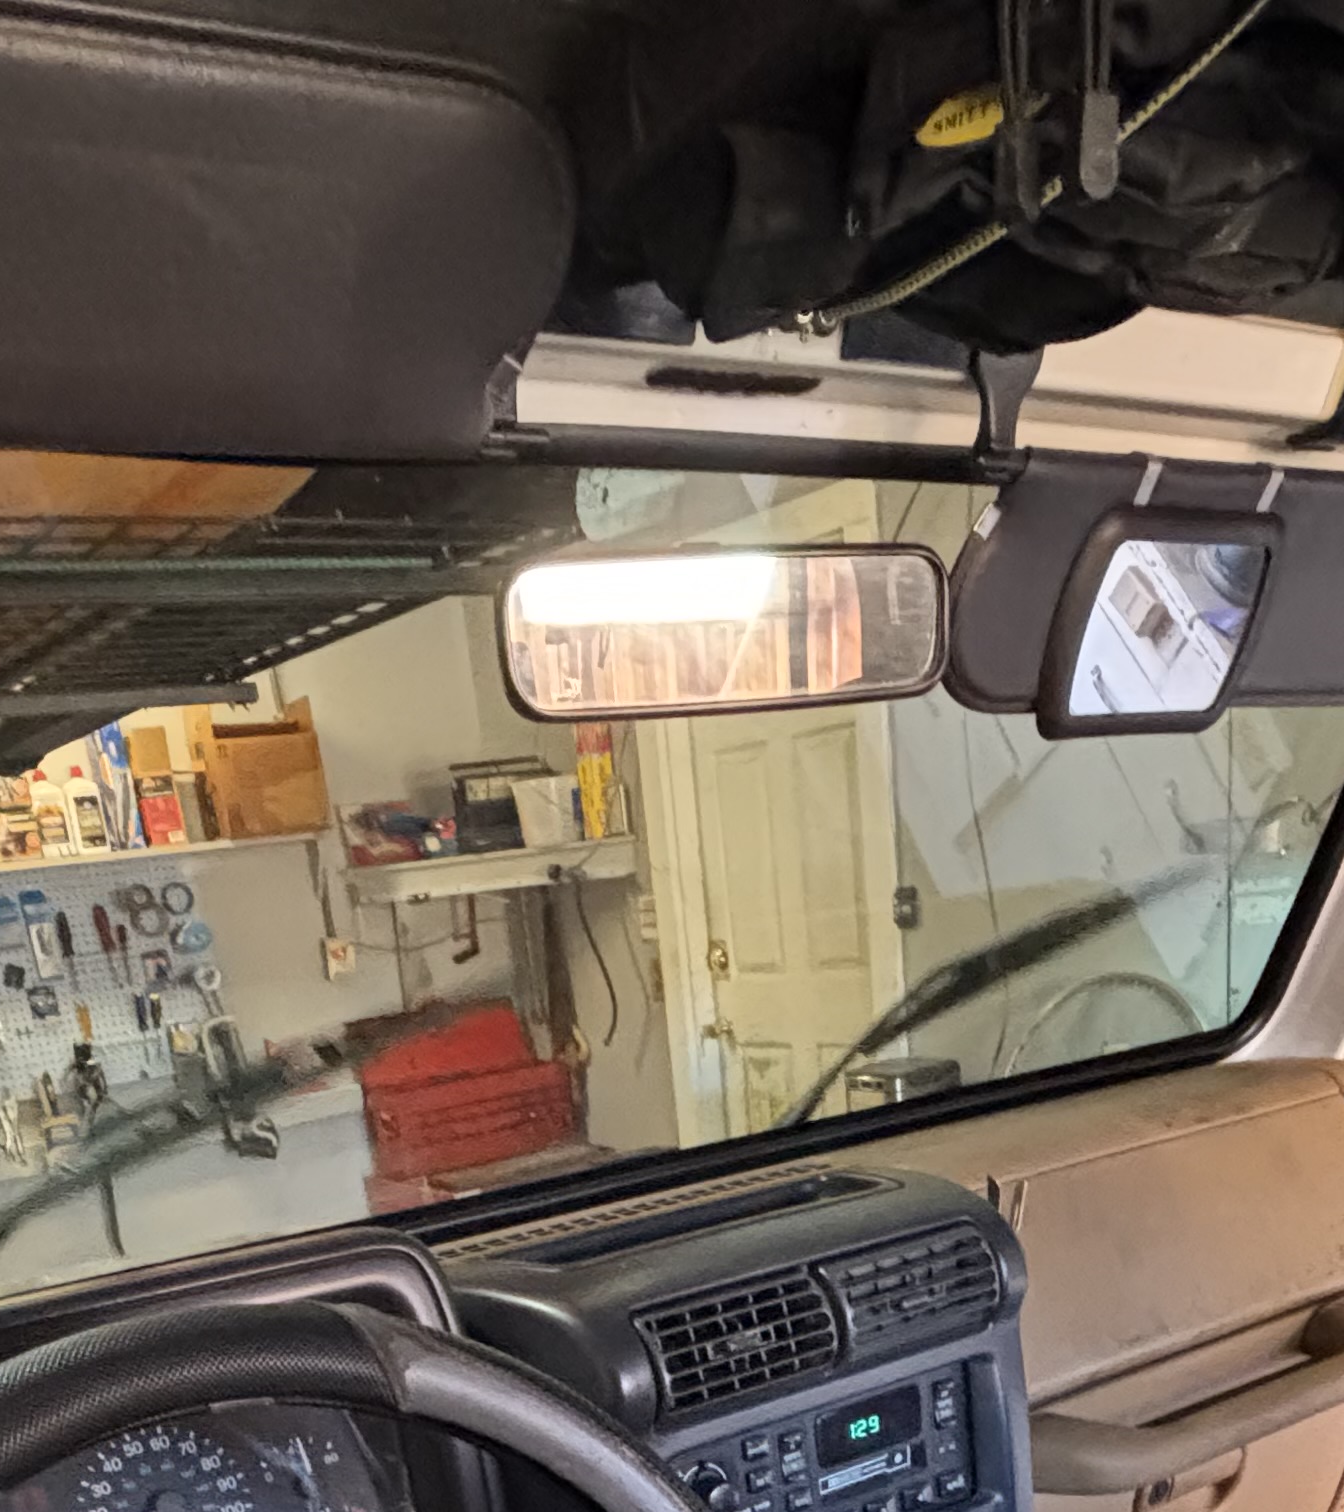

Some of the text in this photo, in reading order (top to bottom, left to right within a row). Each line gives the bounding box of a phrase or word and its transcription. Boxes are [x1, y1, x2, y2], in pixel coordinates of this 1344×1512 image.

[122, 1441, 144, 1457] 50
[149, 1435, 170, 1451] 60
[178, 1440, 197, 1456] 70
[103, 1457, 122, 1473] 40
[200, 1455, 221, 1471] 80
[90, 1481, 112, 1498] 30
[216, 1476, 237, 1492] 90
